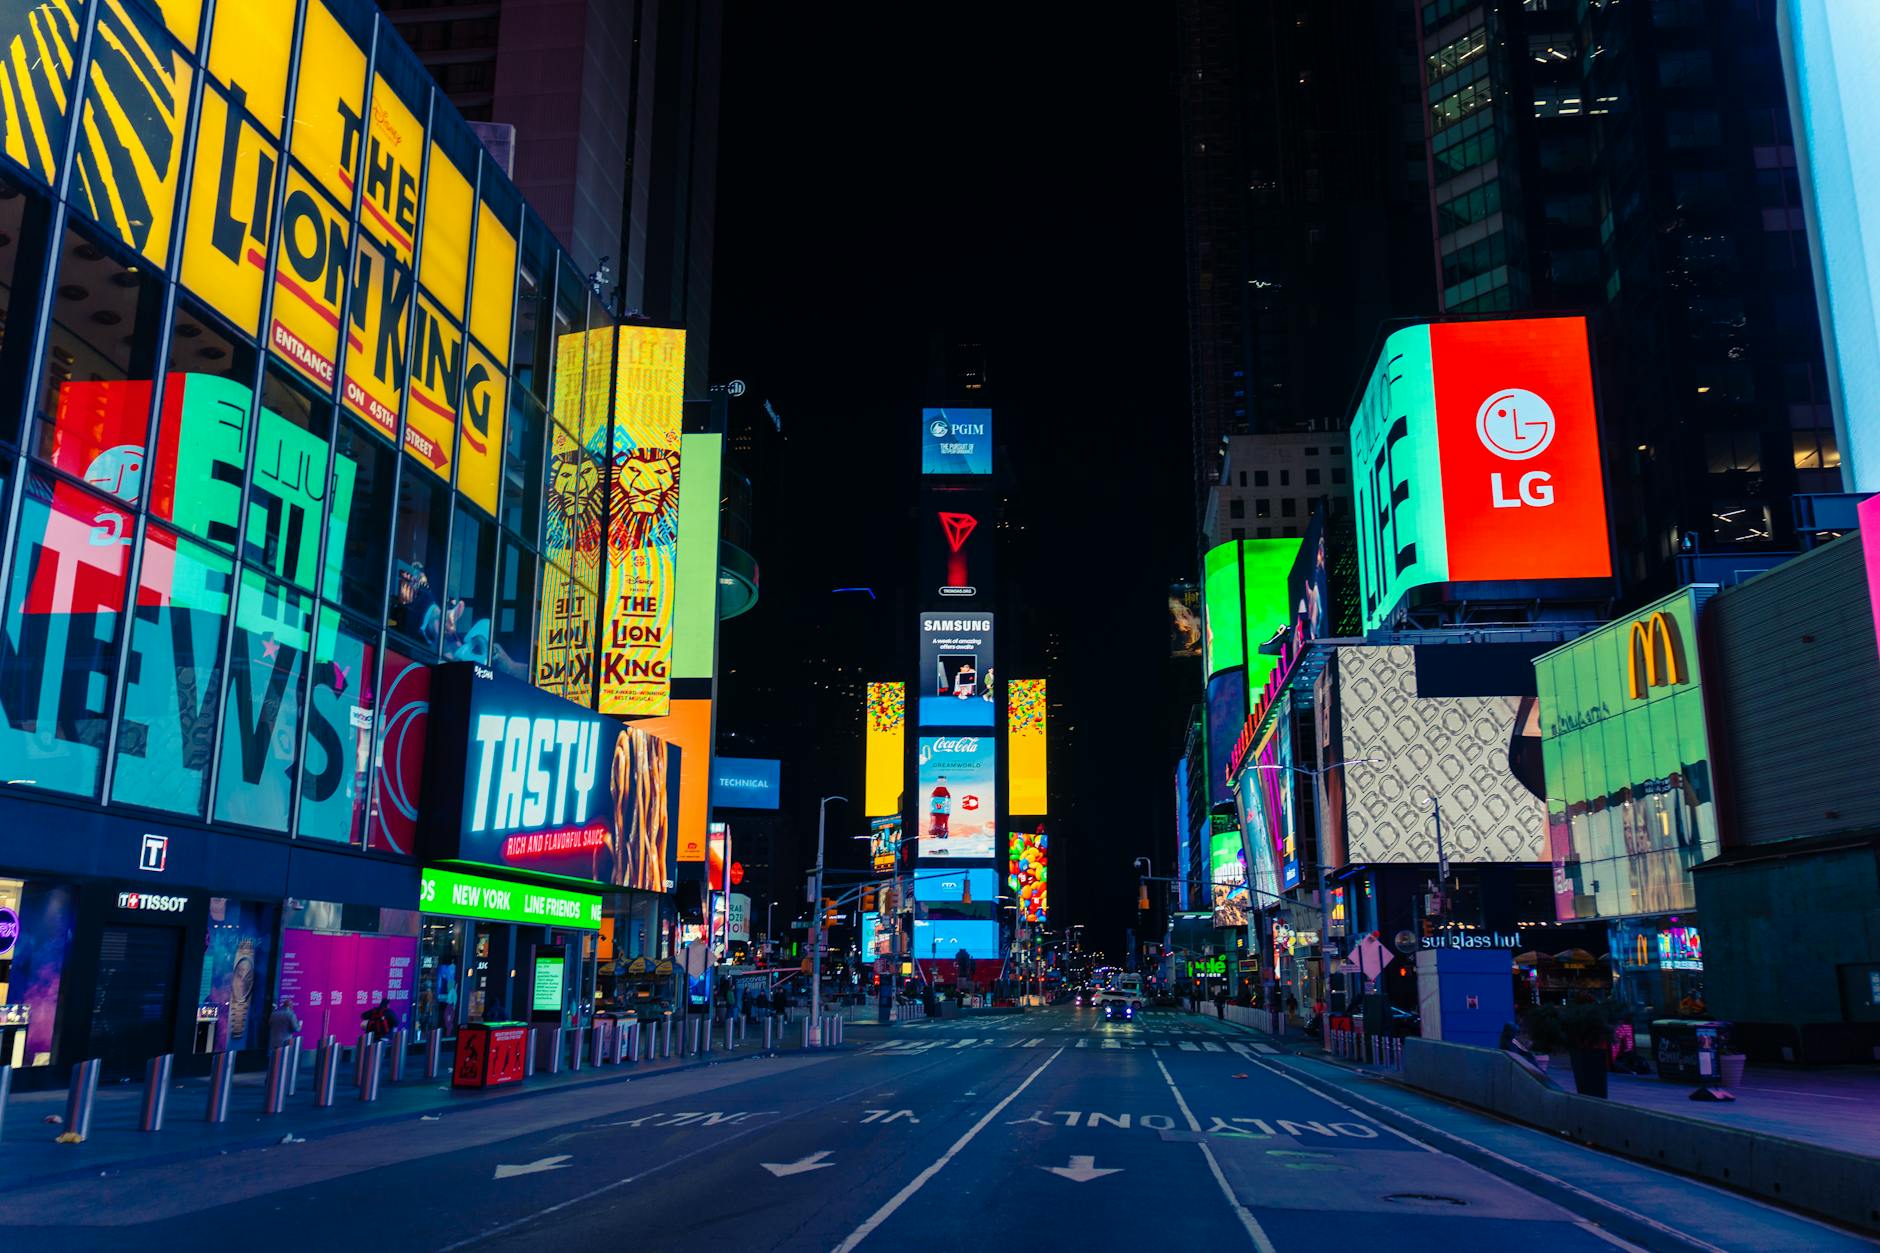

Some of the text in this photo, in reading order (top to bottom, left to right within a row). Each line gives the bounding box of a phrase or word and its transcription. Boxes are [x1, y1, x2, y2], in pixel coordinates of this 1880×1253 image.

[337, 97, 416, 237] THE
[211, 78, 491, 438] LION KING
[275, 327, 433, 457] ENTRANCE ON 45TH STREET
[951, 423, 984, 435] PGIM
[1491, 470, 1554, 508] LG
[624, 574, 654, 589] Disney
[620, 595, 657, 612] THE
[612, 619, 661, 649] LION
[924, 620, 990, 631] SAMSUNG
[603, 652, 667, 686] KING
[471, 714, 601, 832] TASTY
[719, 778, 769, 789] TECHNICAL
[1359, 746, 1433, 822] BOLD
[1390, 756, 1464, 833] BOLD
[507, 829, 604, 855] RICH AND FLAVORFUL SAUCE
[138, 894, 188, 912] TISSOT
[452, 883, 481, 907] NEW
[483, 887, 511, 910] YORK
[524, 894, 545, 914] LINE
[545, 898, 581, 919] FRIENDS
[1494, 931, 1522, 948] hut
[1005, 1110, 1176, 1131] ONLY
[1210, 1115, 1380, 1138] ONLY
